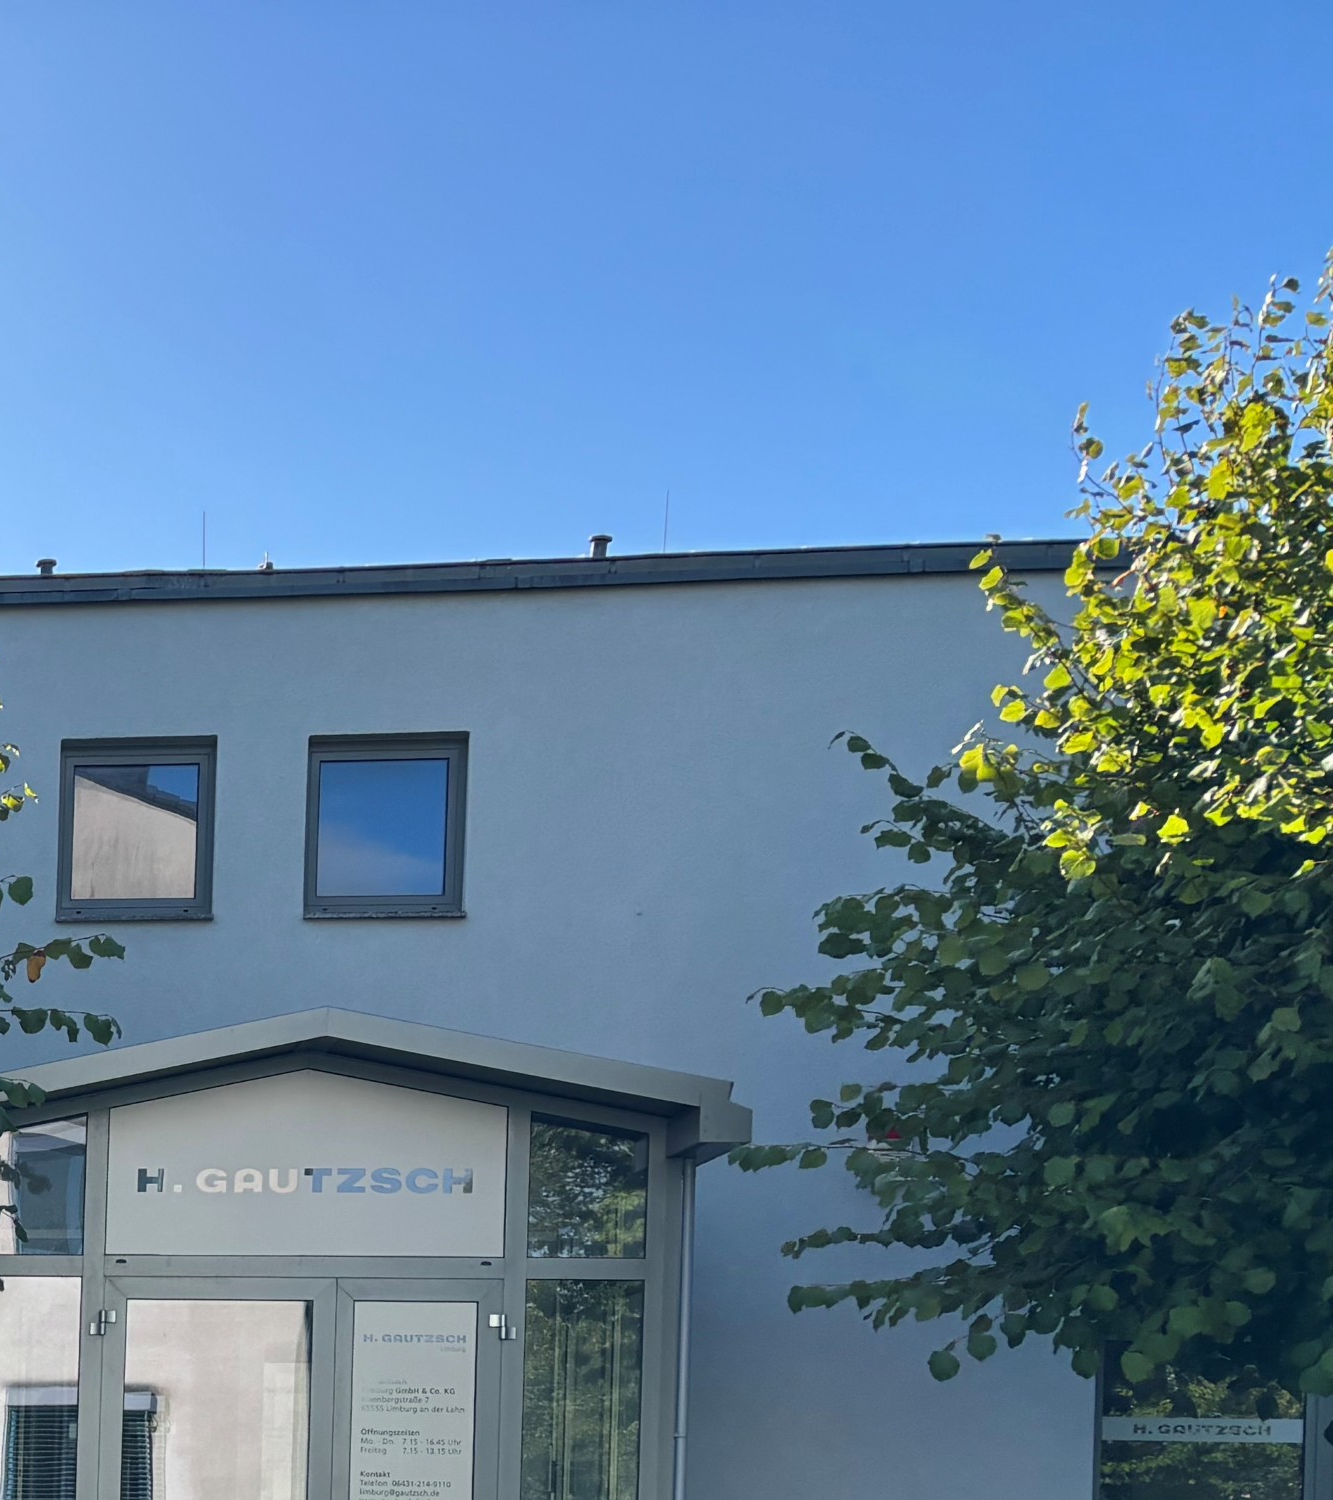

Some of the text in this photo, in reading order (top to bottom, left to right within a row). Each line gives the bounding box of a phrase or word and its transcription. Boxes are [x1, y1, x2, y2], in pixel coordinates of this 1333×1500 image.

[136, 1167, 474, 1194] H. GAUTZSCH
[363, 1334, 467, 1344] H. GAUTZSCH
[395, 1387, 419, 1395] GmbH
[429, 1387, 441, 1395] Co.
[1133, 1424, 1271, 1436] H. GAUTZSCH
